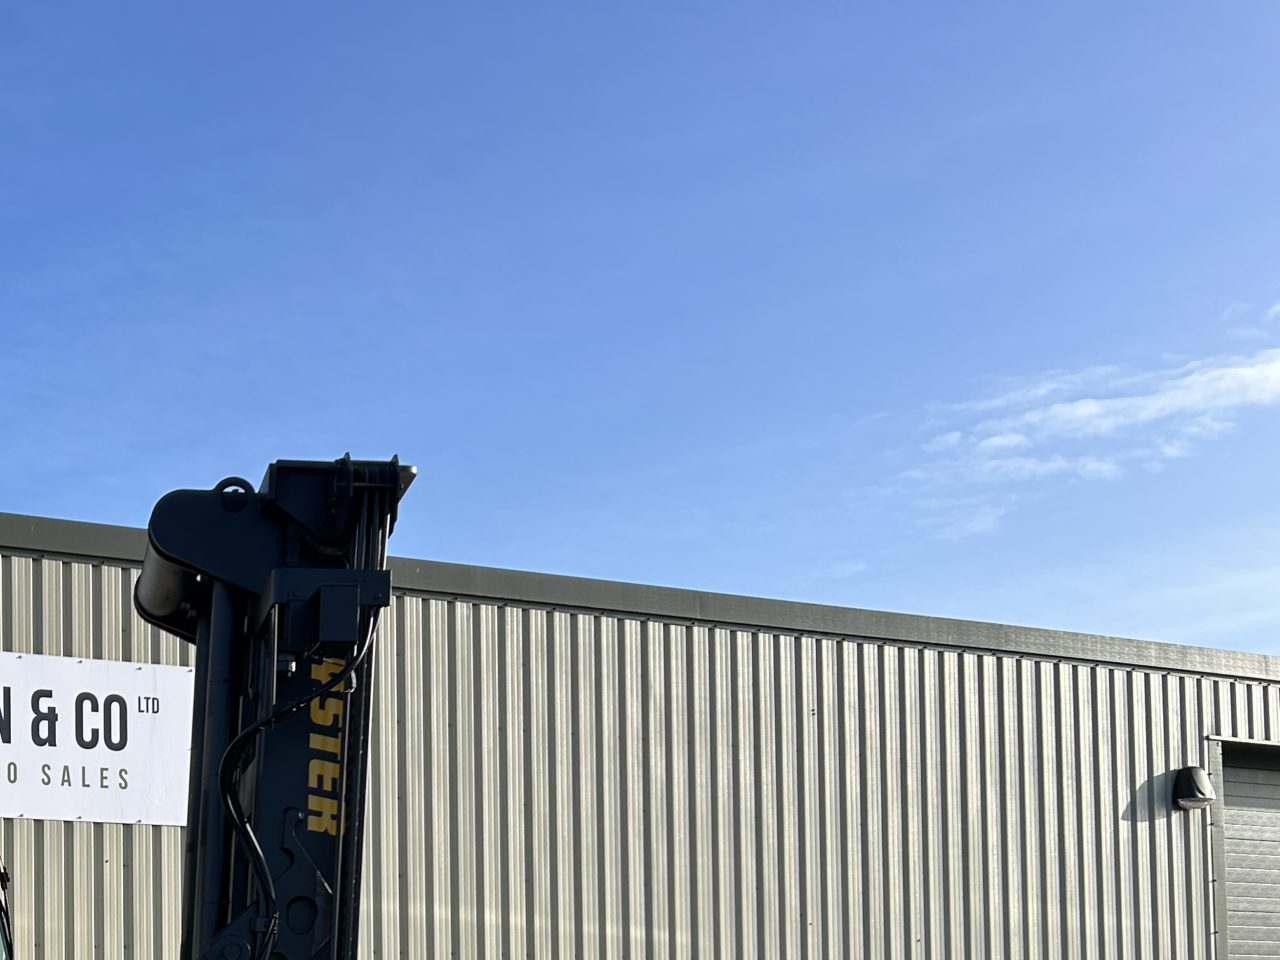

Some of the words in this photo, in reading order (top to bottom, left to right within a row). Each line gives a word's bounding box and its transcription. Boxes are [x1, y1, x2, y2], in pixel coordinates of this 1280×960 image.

[31, 689, 58, 747] &
[74, 692, 128, 752] CO
[137, 696, 160, 714] LTD
[307, 657, 346, 837] YSTER
[41, 763, 128, 790] SALES
